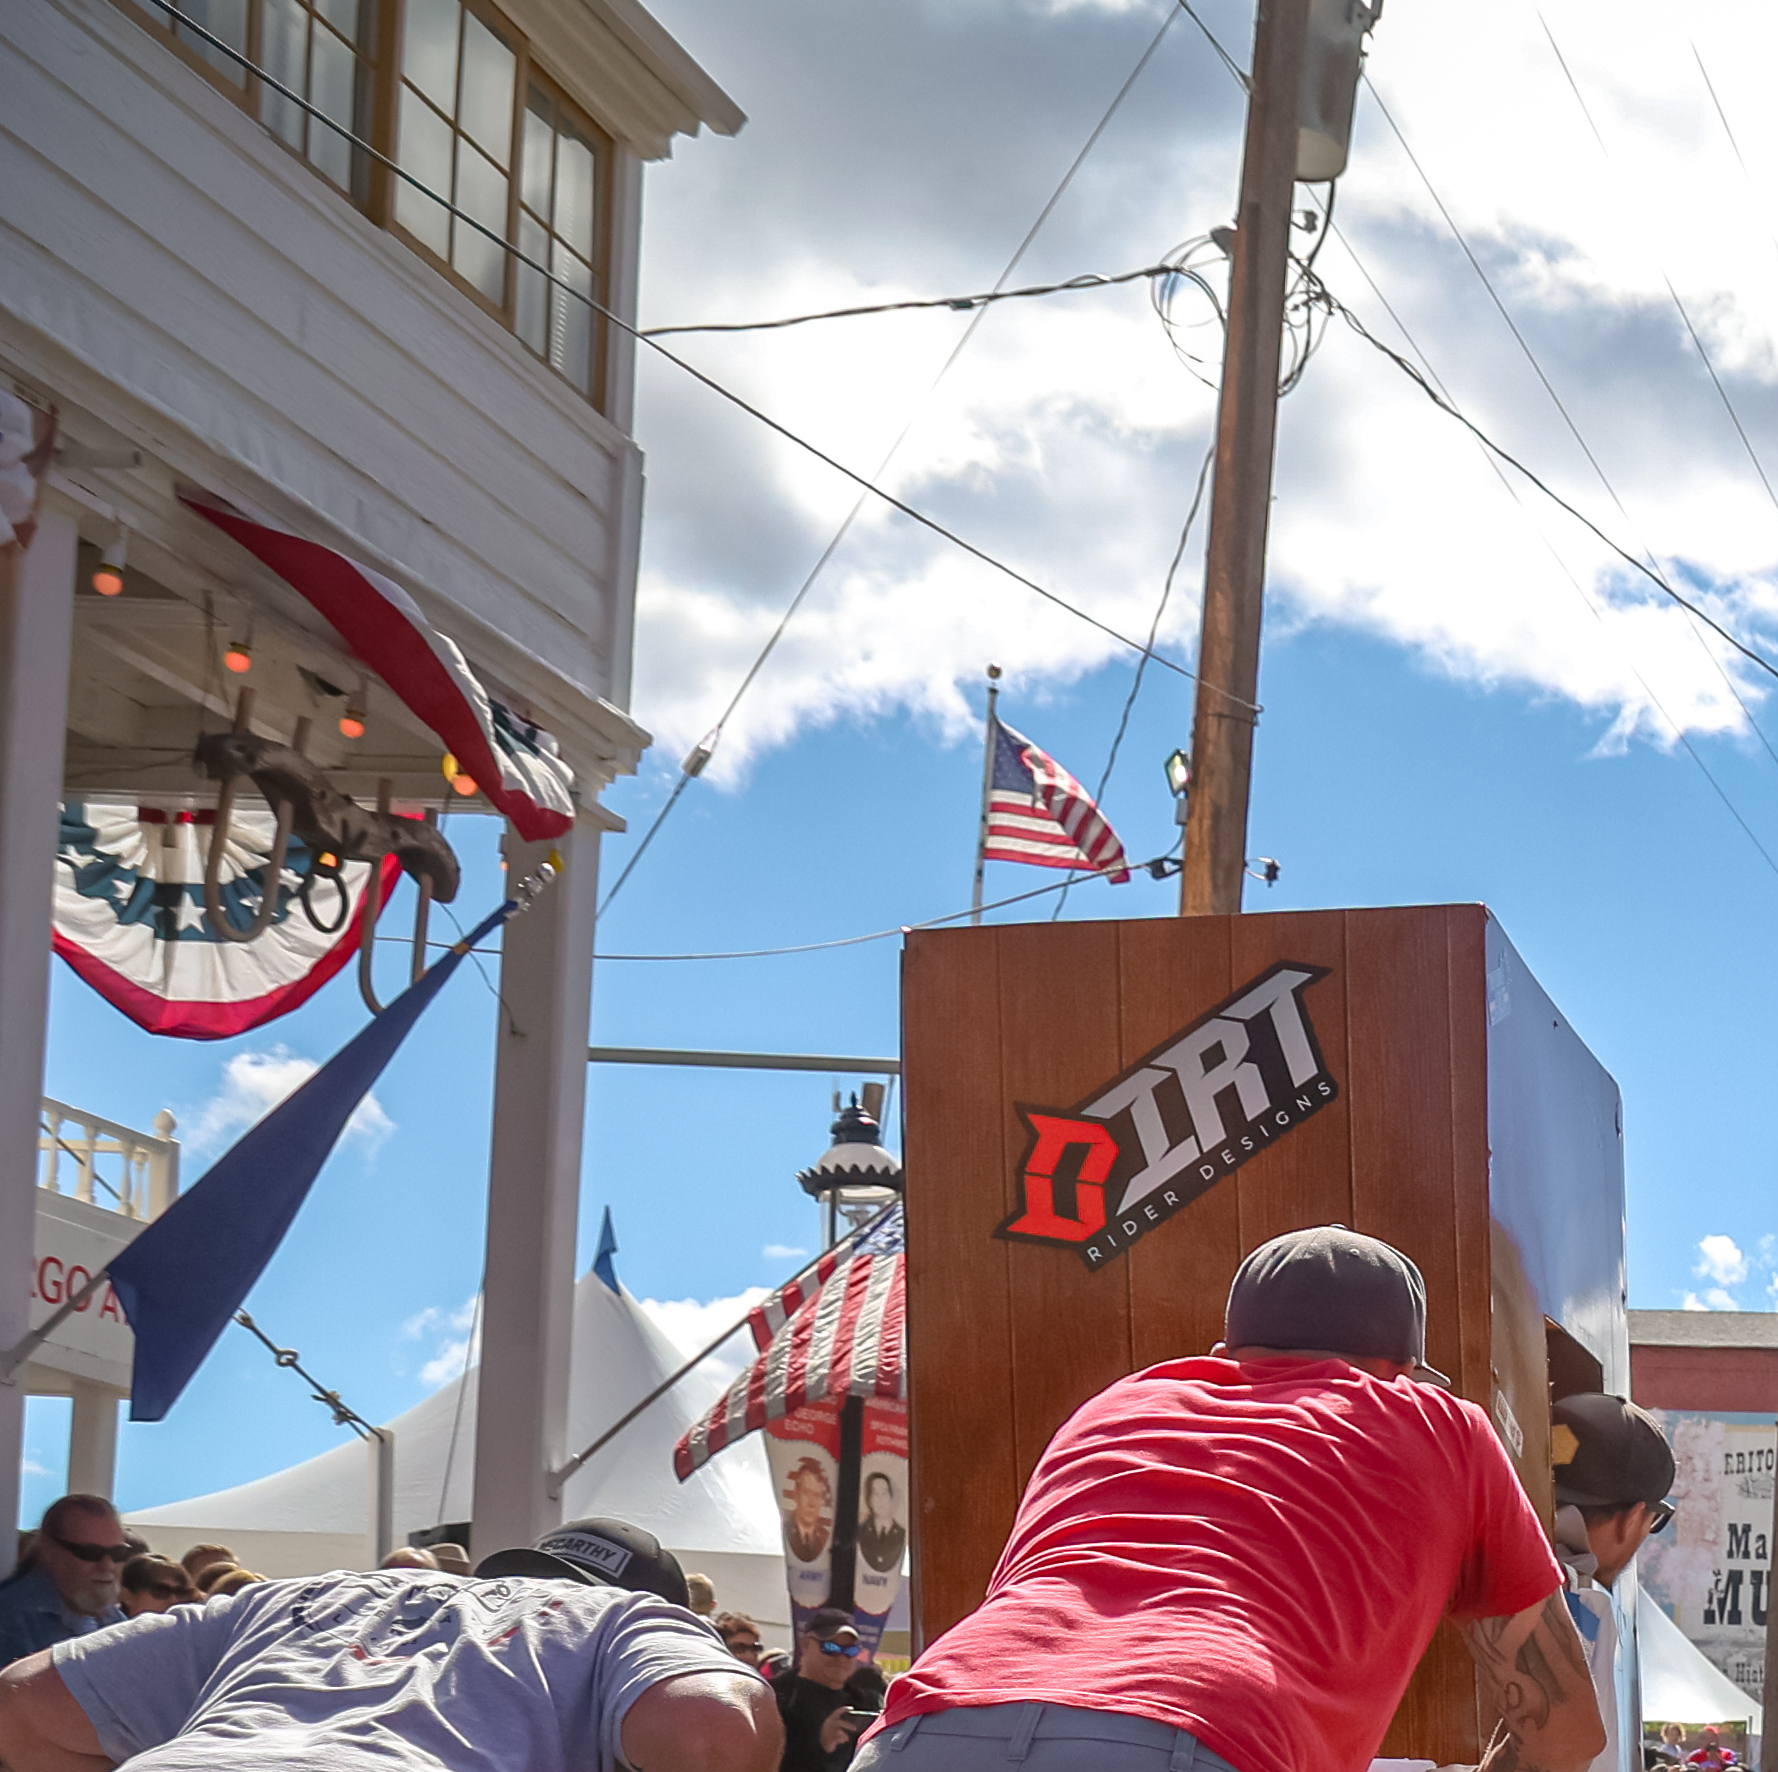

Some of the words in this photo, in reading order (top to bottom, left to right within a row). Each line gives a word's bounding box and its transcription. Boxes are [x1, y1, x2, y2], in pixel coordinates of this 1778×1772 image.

[1006, 969, 1318, 1242] DIRT
[1086, 1190, 1179, 1262] RIDER
[1199, 1082, 1331, 1180] DESIGNS
